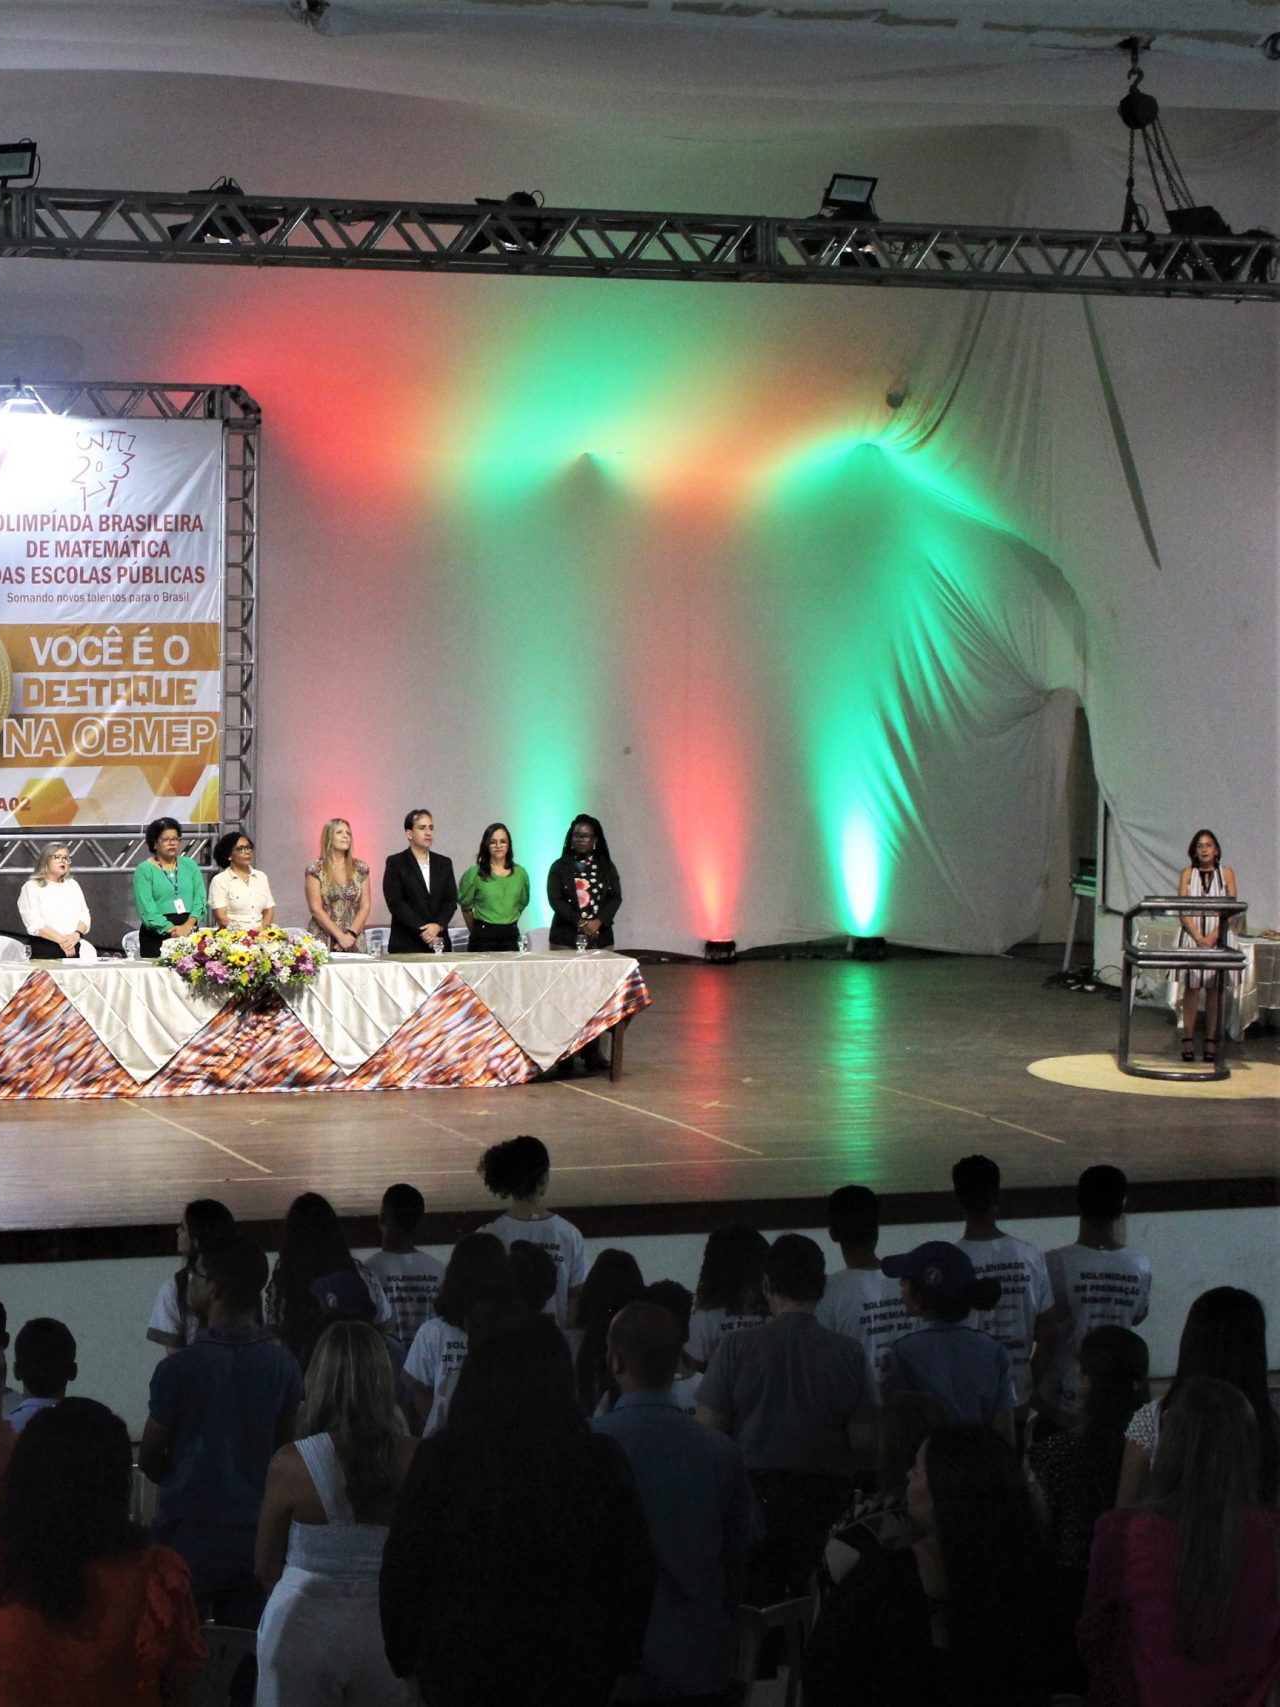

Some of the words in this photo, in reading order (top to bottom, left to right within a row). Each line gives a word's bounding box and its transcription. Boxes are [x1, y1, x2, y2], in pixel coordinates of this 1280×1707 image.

[98, 514, 204, 532] BRASILEIRA
[26, 540, 49, 558] DE
[55, 535, 171, 558] MATEMÁTICA
[31, 566, 112, 584] ESCOLAS
[117, 561, 205, 584] PÚBLICAS
[7, 592, 54, 603] Somando
[57, 594, 84, 603] novos
[87, 592, 126, 603] talentos
[129, 594, 151, 605] para
[153, 594, 160, 602] o
[162, 591, 189, 602] Brasil
[30, 625, 124, 667] VOCÊ
[133, 627, 154, 666] É
[163, 635, 190, 666] O
[22, 675, 197, 708] DESTAQUE
[2, 716, 66, 758] NA
[72, 716, 217, 757] OBMEP
[1079, 1272, 1139, 1283] SOLENIDADE
[1089, 1284, 1141, 1296] PREMIAÇÃO
[863, 1298, 905, 1310] SOLENIDA
[873, 1310, 905, 1321] PREMIA
